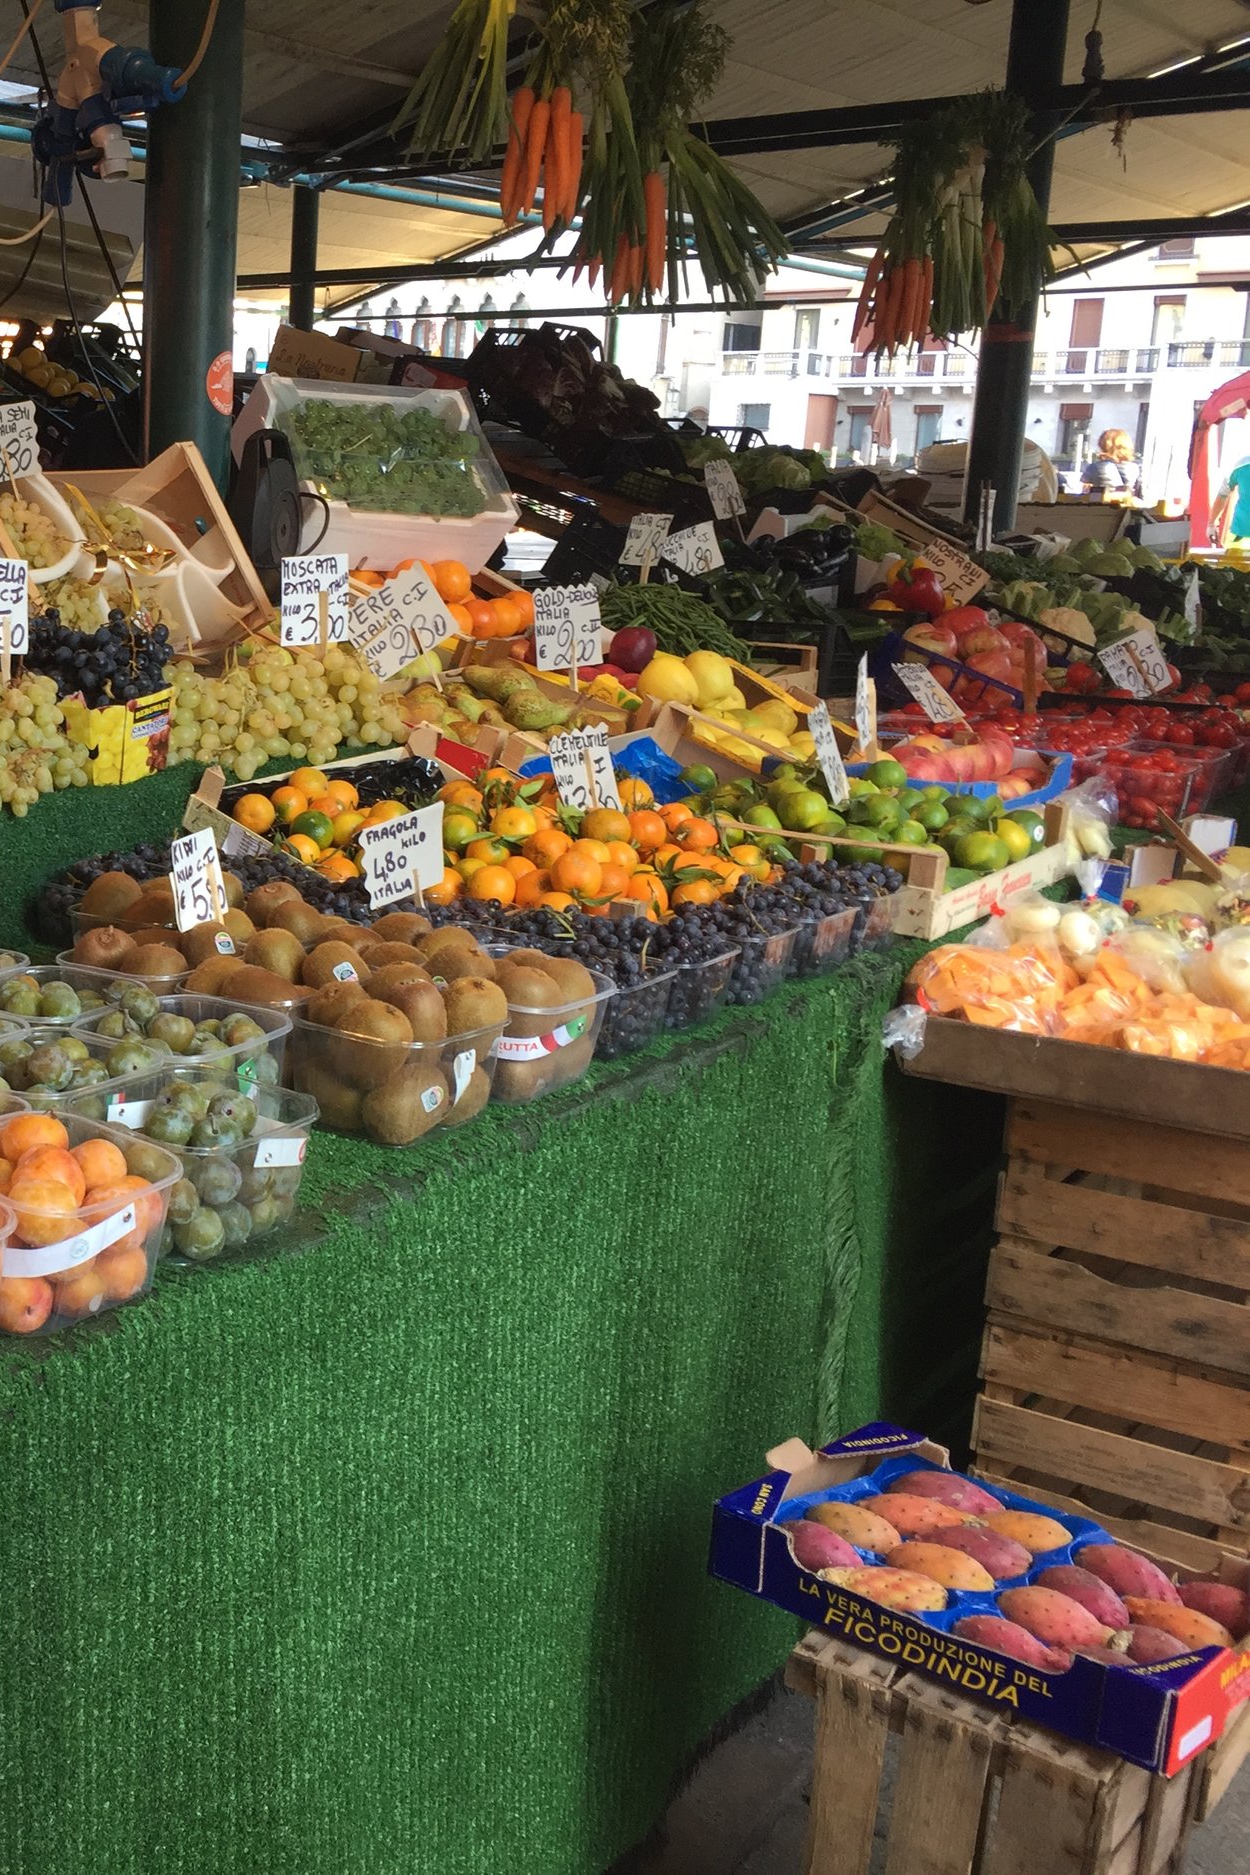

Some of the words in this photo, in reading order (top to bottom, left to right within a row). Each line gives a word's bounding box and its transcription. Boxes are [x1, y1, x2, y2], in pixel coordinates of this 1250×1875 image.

[7, 405, 30, 422] SEMI
[281, 556, 338, 580] MOSCATA
[283, 578, 321, 597] EXTRA
[282, 604, 301, 617] KILO
[536, 607, 570, 621] ITALIA
[285, 626, 294, 642] €
[352, 607, 404, 648] ITALIA
[536, 624, 556, 637] KILO
[539, 644, 548, 659] €
[365, 815, 419, 846] FRAGOLA
[401, 831, 427, 849] KILO
[373, 877, 413, 901] ITALIA
[799, 1577, 822, 1599] LA
[826, 1589, 874, 1623] VERA
[880, 1614, 1008, 1680] PRODUZIONE
[1013, 1671, 1054, 1699] DEL
[823, 1607, 1021, 1709] FICODINDIA
